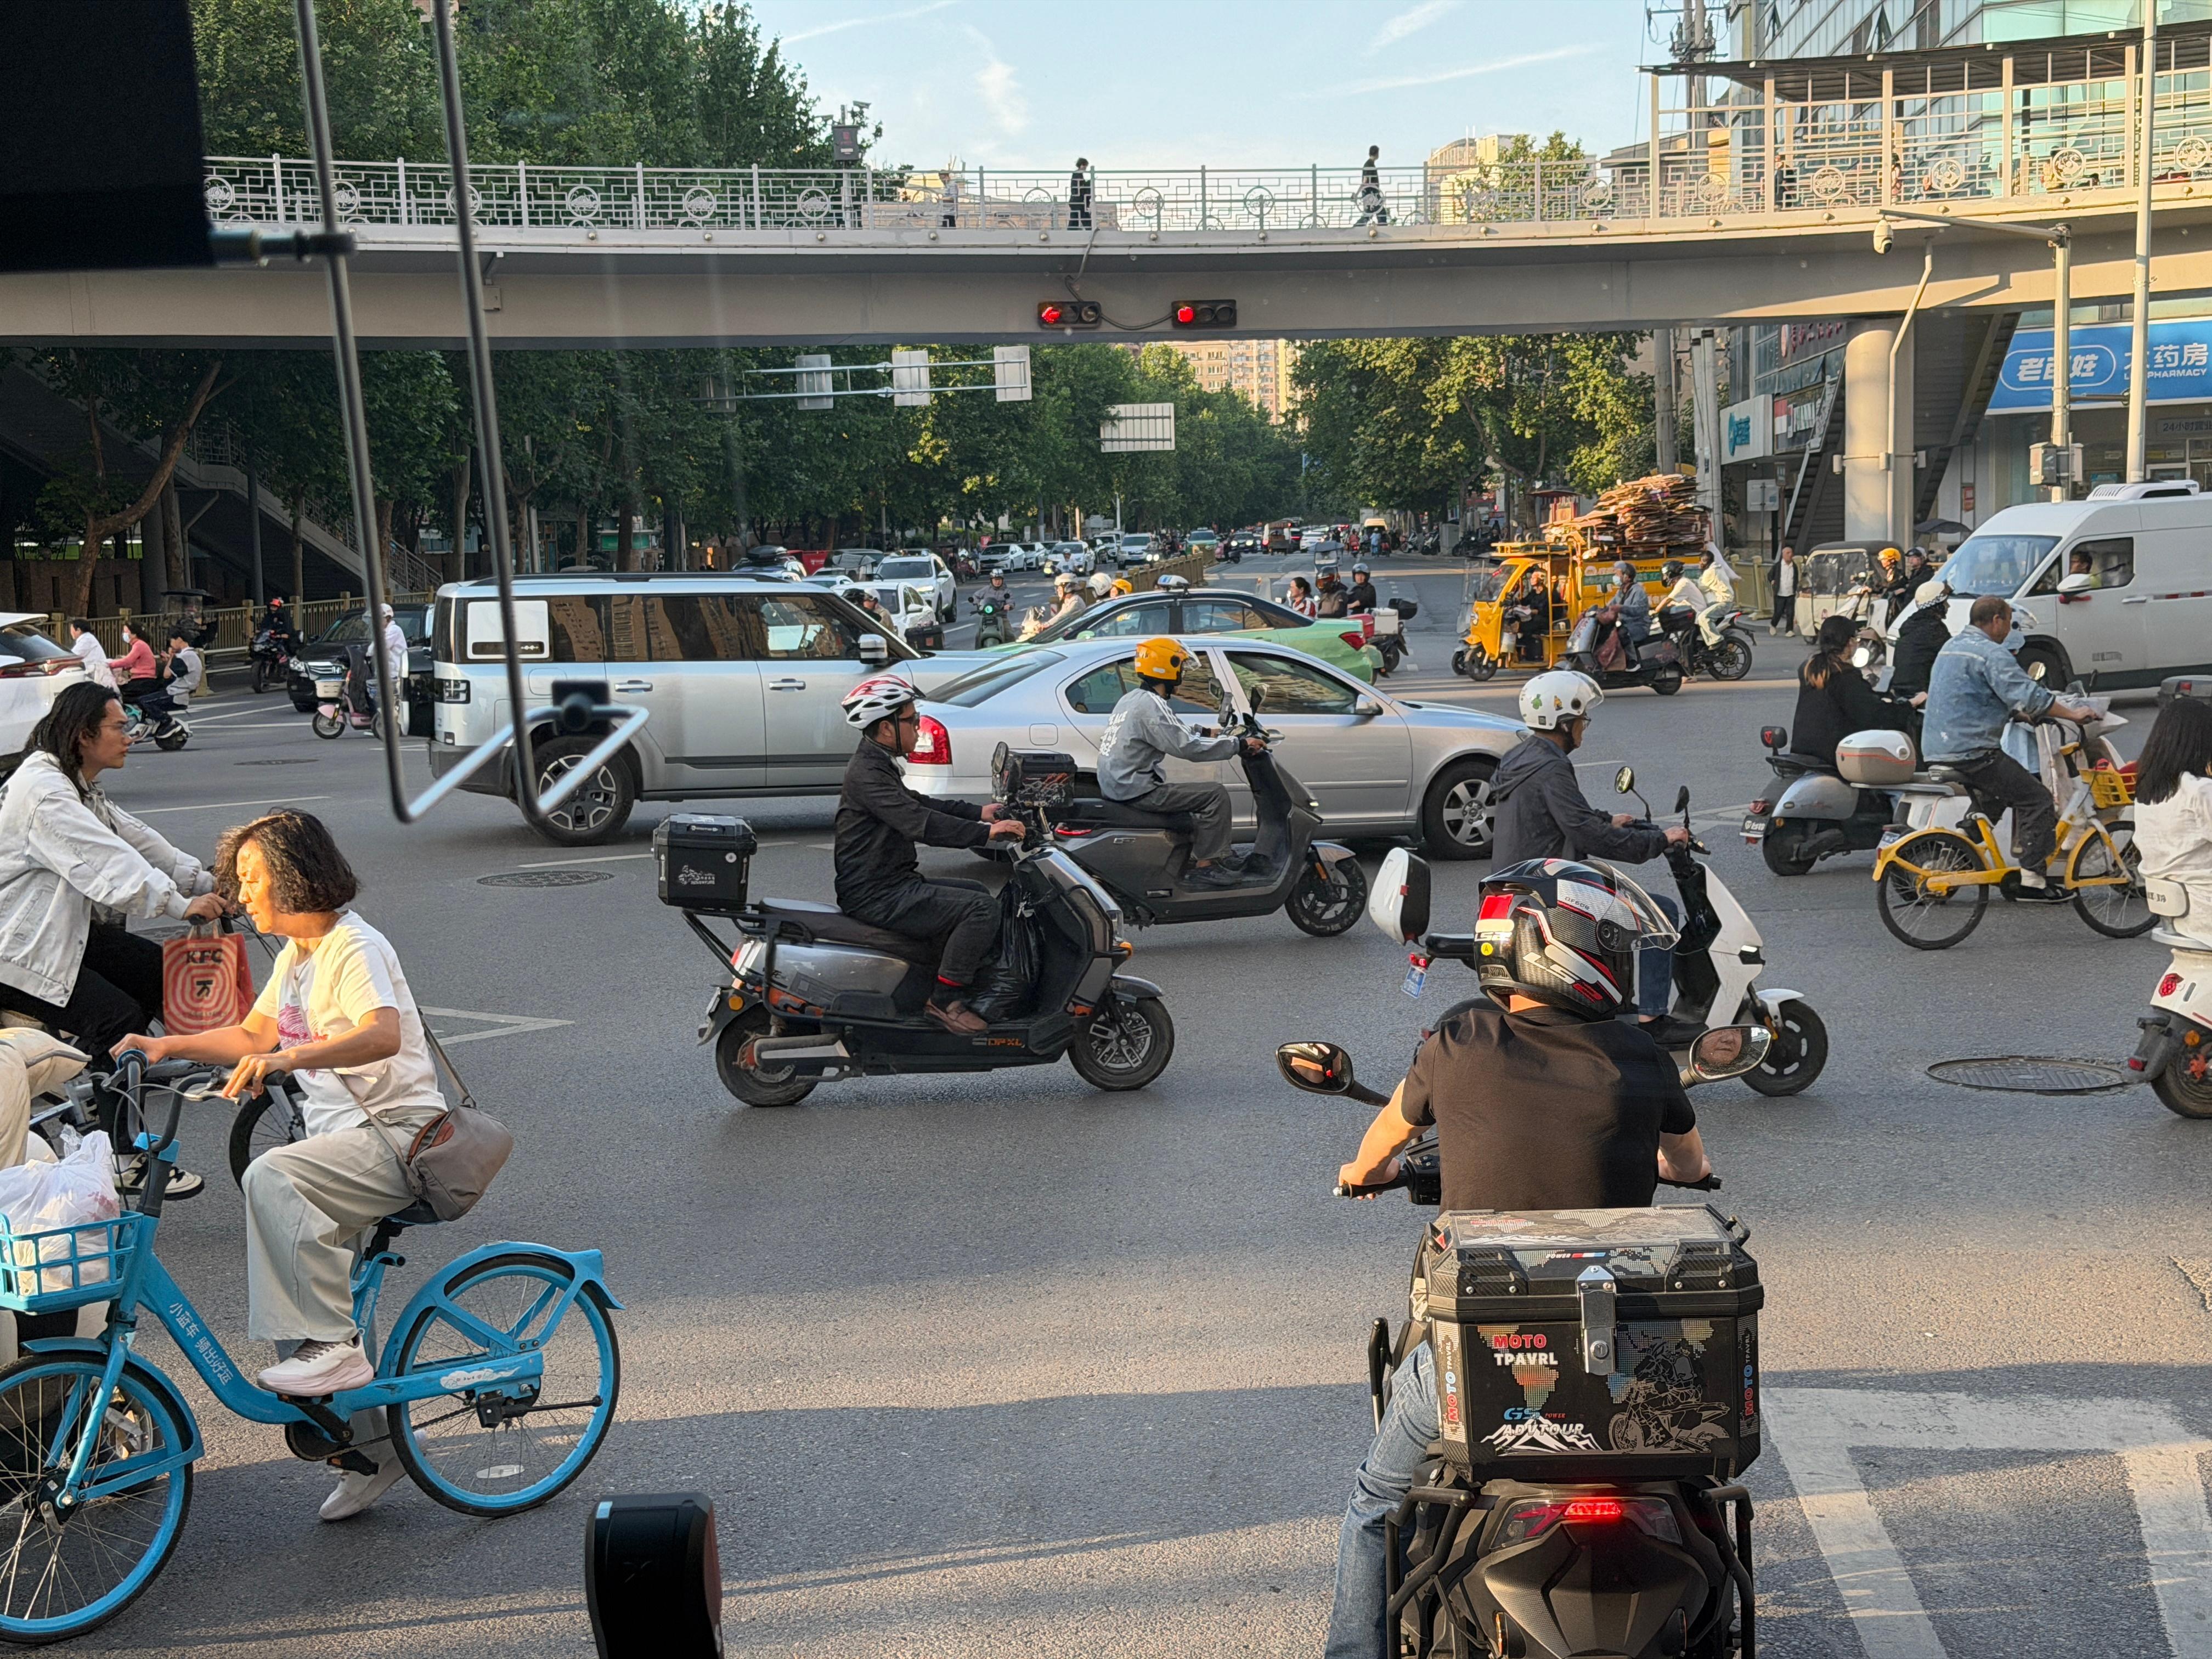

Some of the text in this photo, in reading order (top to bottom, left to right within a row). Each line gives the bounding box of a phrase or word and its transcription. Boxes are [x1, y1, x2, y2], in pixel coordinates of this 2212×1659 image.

[2147, 368, 2207, 379] PHARMACY
[187, 949, 223, 964] KFC
[169, 1302, 234, 1386] 小蓝车 骑出好运
[1493, 1334, 1547, 1349] MOTO
[1493, 1352, 1559, 1366] TPAVRL
[1445, 1371, 1460, 1423] MOTO
[1743, 1364, 1754, 1416] MOTO
[1504, 1407, 1541, 1420] GS
[1503, 1424, 1584, 1437] ADVTOUR
